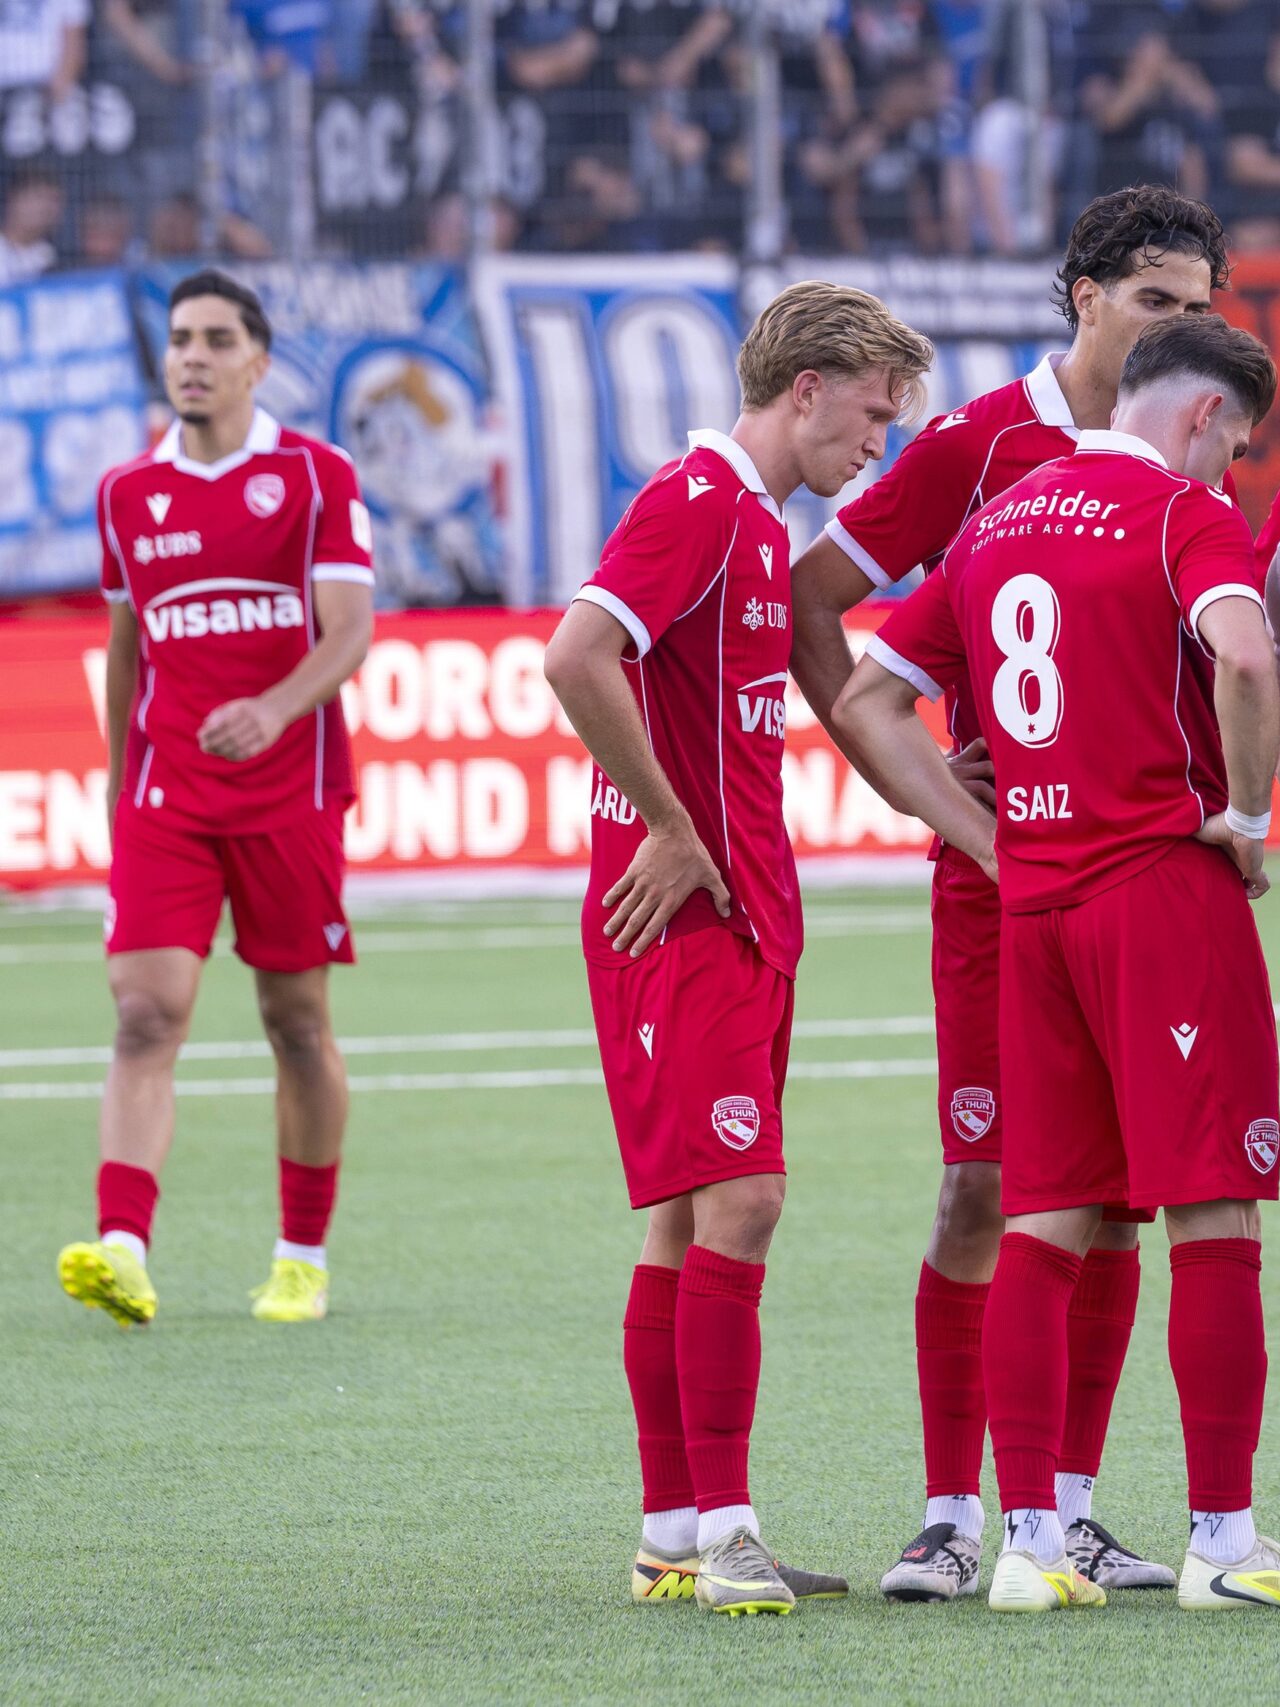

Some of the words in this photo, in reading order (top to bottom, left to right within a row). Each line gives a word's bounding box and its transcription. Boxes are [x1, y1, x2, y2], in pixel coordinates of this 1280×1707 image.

[976, 489, 1120, 536] schneider
[156, 530, 202, 559] UBS
[971, 523, 1032, 554] SOFTWARE
[1043, 523, 1063, 535] AG
[766, 602, 787, 630] UBS
[991, 573, 1064, 749] 8
[1007, 784, 1073, 822] SAIZ
[717, 1110, 728, 1120] FC
[729, 1109, 755, 1118] THUN
[954, 1102, 963, 1111] FC
[965, 1100, 990, 1110] THUN
[1250, 1132, 1260, 1142] FC
[1261, 1132, 1278, 1142] THUN
